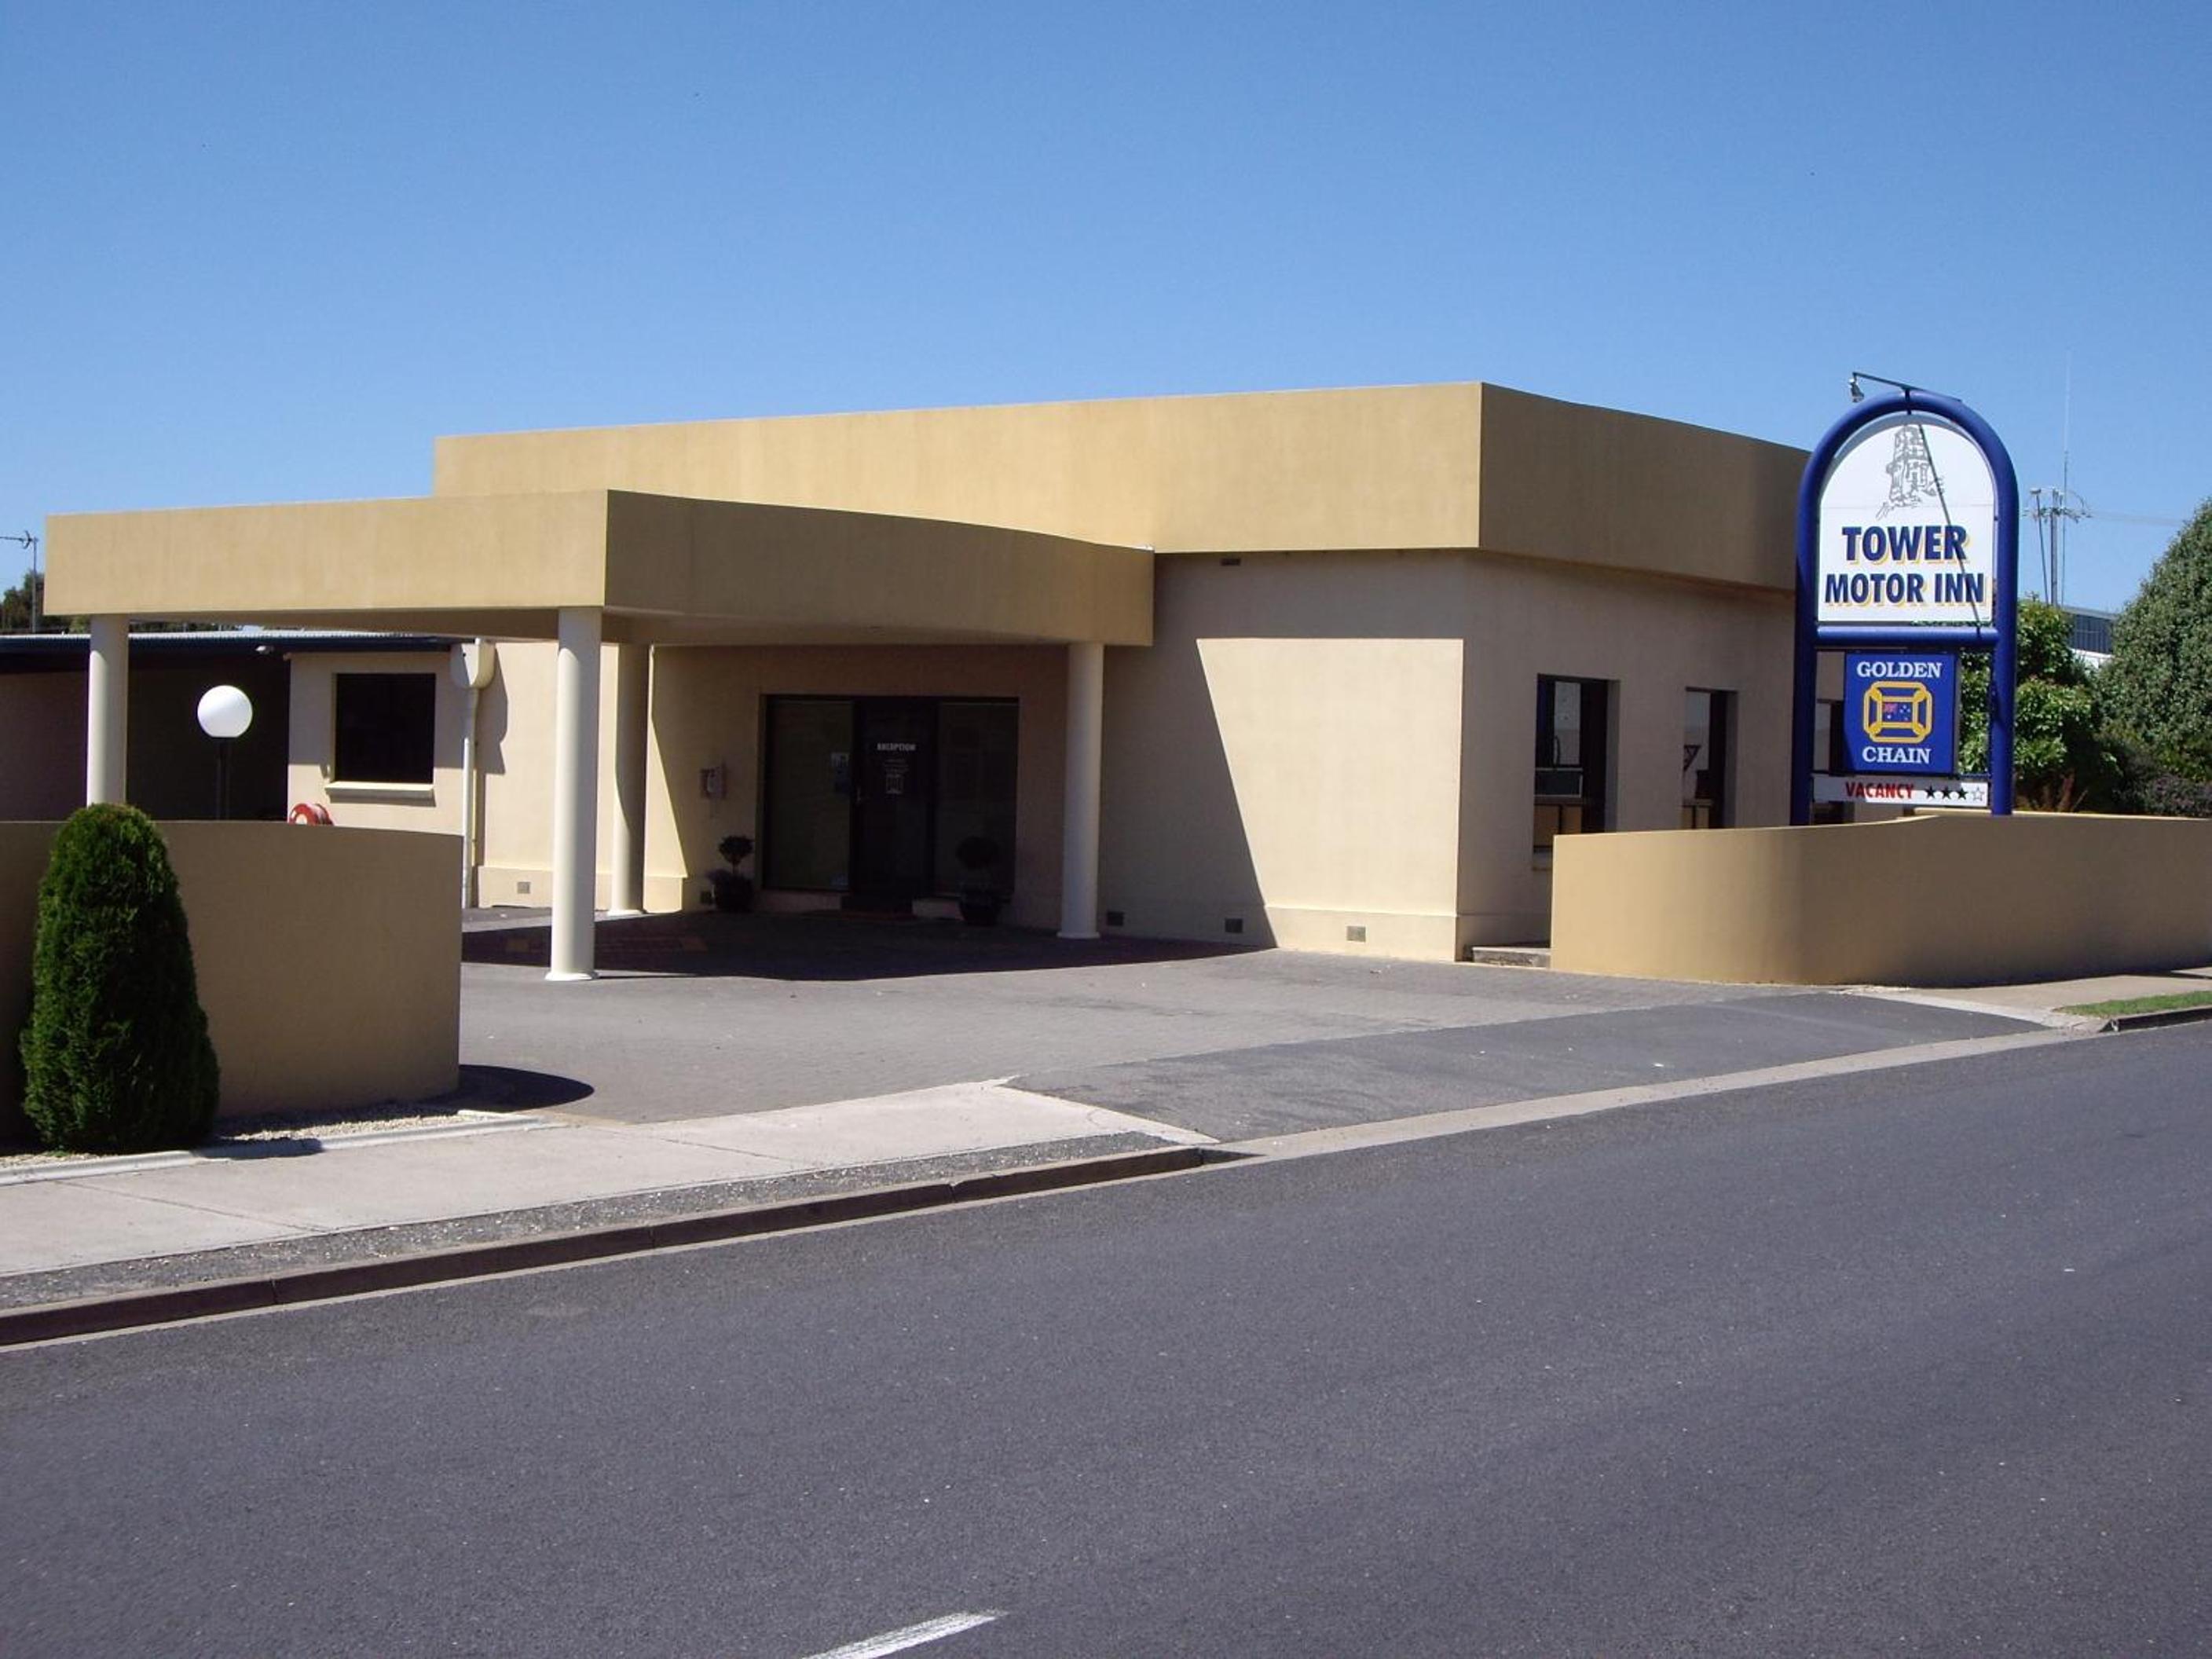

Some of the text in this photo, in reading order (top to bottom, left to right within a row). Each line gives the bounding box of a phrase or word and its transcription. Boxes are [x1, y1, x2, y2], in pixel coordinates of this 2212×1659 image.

[1842, 526, 1968, 562] TOWER
[1825, 573, 1985, 604] MOTOR INN
[1857, 661, 1943, 678] GOLDEN
[1862, 746, 1932, 764] CHAIN
[1846, 782, 1915, 799] VACANCY
